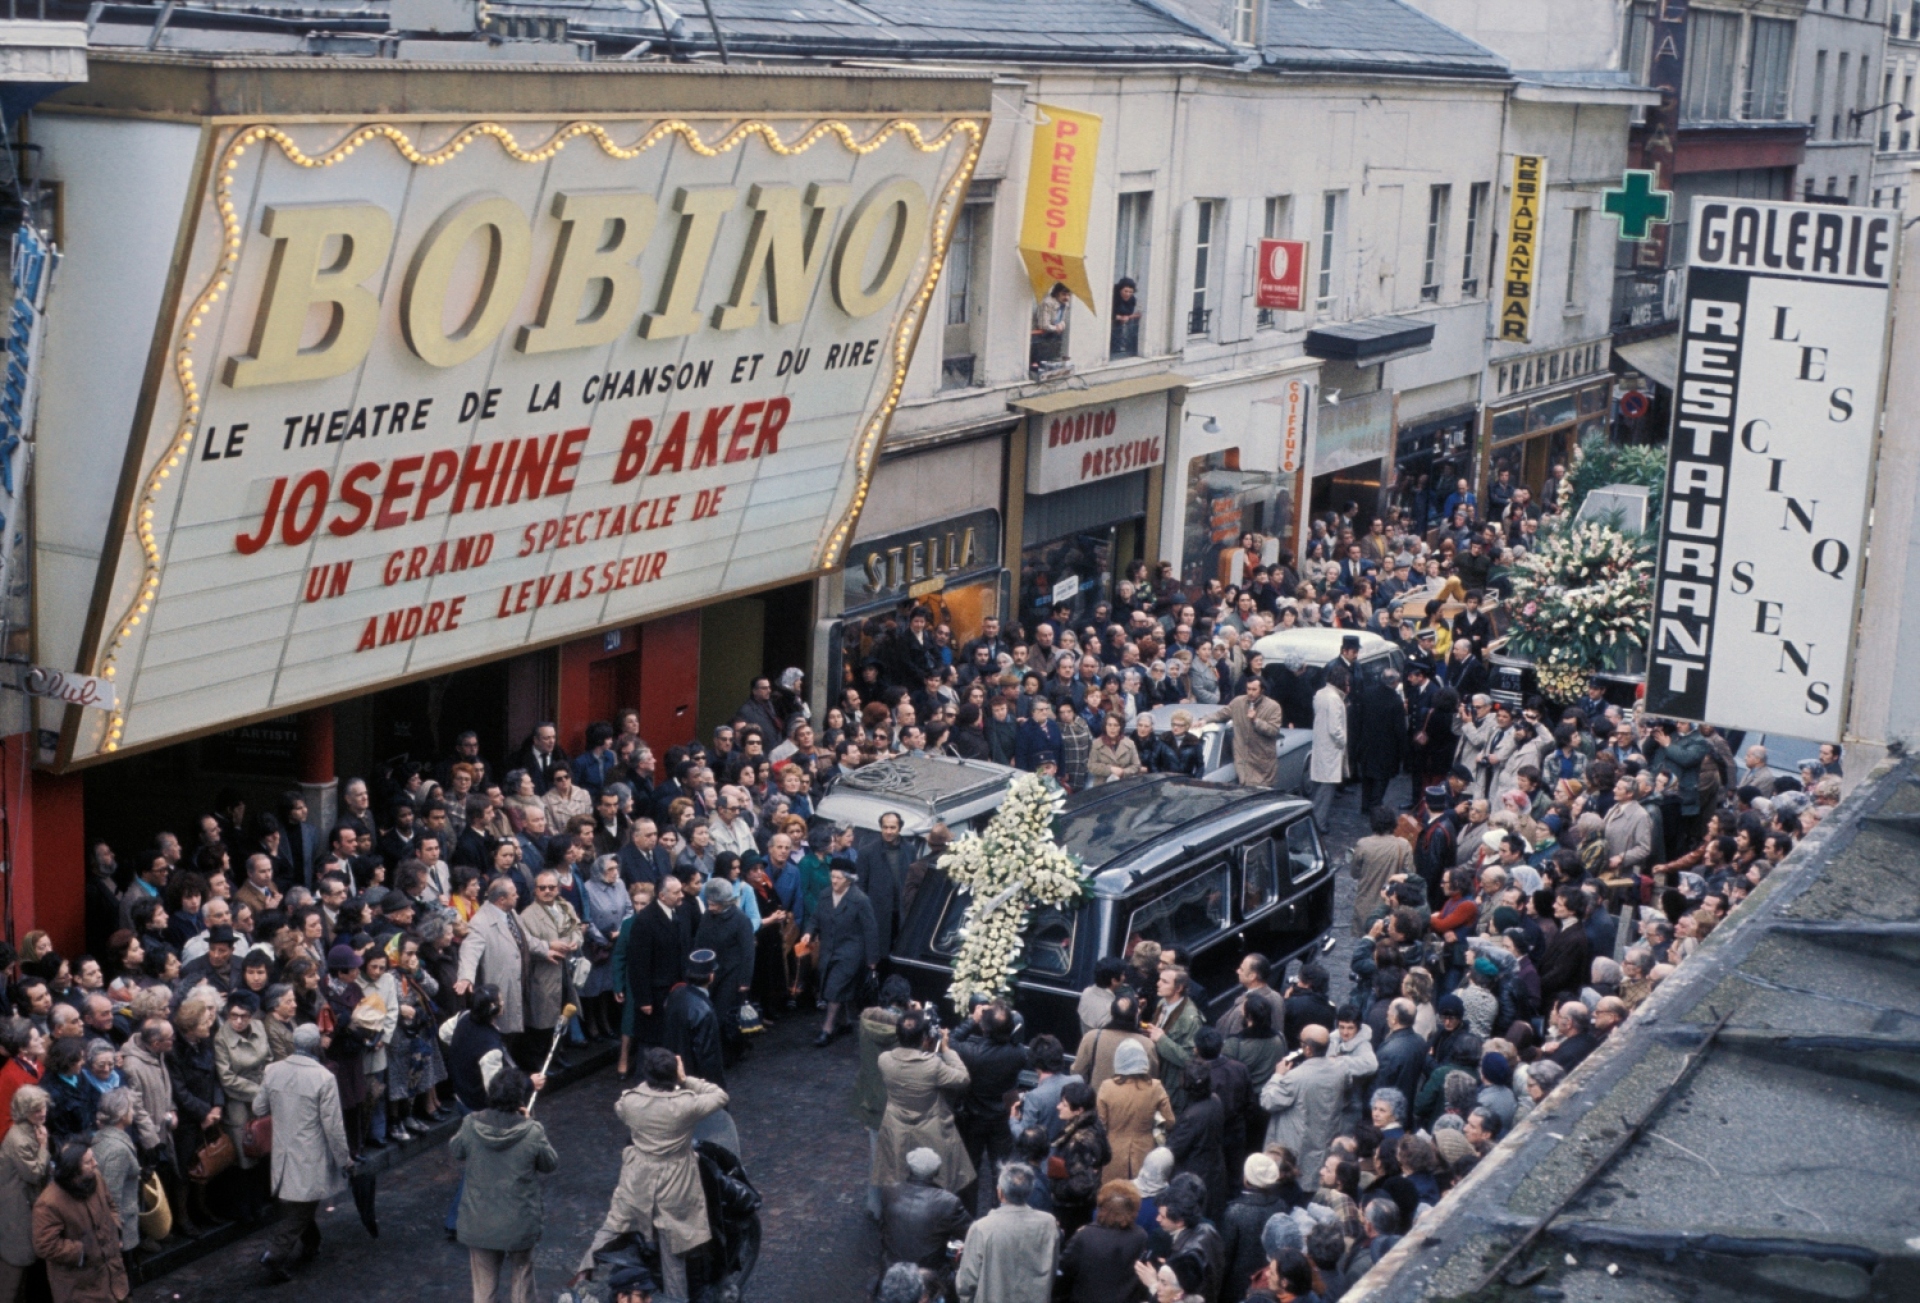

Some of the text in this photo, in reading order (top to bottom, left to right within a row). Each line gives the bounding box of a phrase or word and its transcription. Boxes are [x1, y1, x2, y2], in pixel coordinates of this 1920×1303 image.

[1040, 119, 1080, 280] PRESSING
[1503, 156, 1539, 338] RESTAURANT BAR
[1698, 204, 1889, 279] GALERIE
[222, 174, 929, 389] BOBINO
[201, 339, 879, 461] LE THEATRE DE LA CHANSON ET DU RIRE
[1497, 343, 1601, 395] PHARMACIE
[1769, 305, 1854, 423] LES
[235, 397, 792, 553] JOSEPHINE BAKER
[1048, 407, 1117, 449] BOBINO
[1081, 436, 1160, 480] PRESSING
[306, 485, 727, 604] UN GRAND SPECTACLE DE
[1655, 298, 1742, 693] RESTAURANT
[1741, 419, 1850, 580] CINQ
[355, 551, 669, 653] ANDRE LEVASSEUR
[863, 526, 976, 594] STELLA
[23, 668, 102, 705] Club
[1730, 561, 1830, 715] SENS
